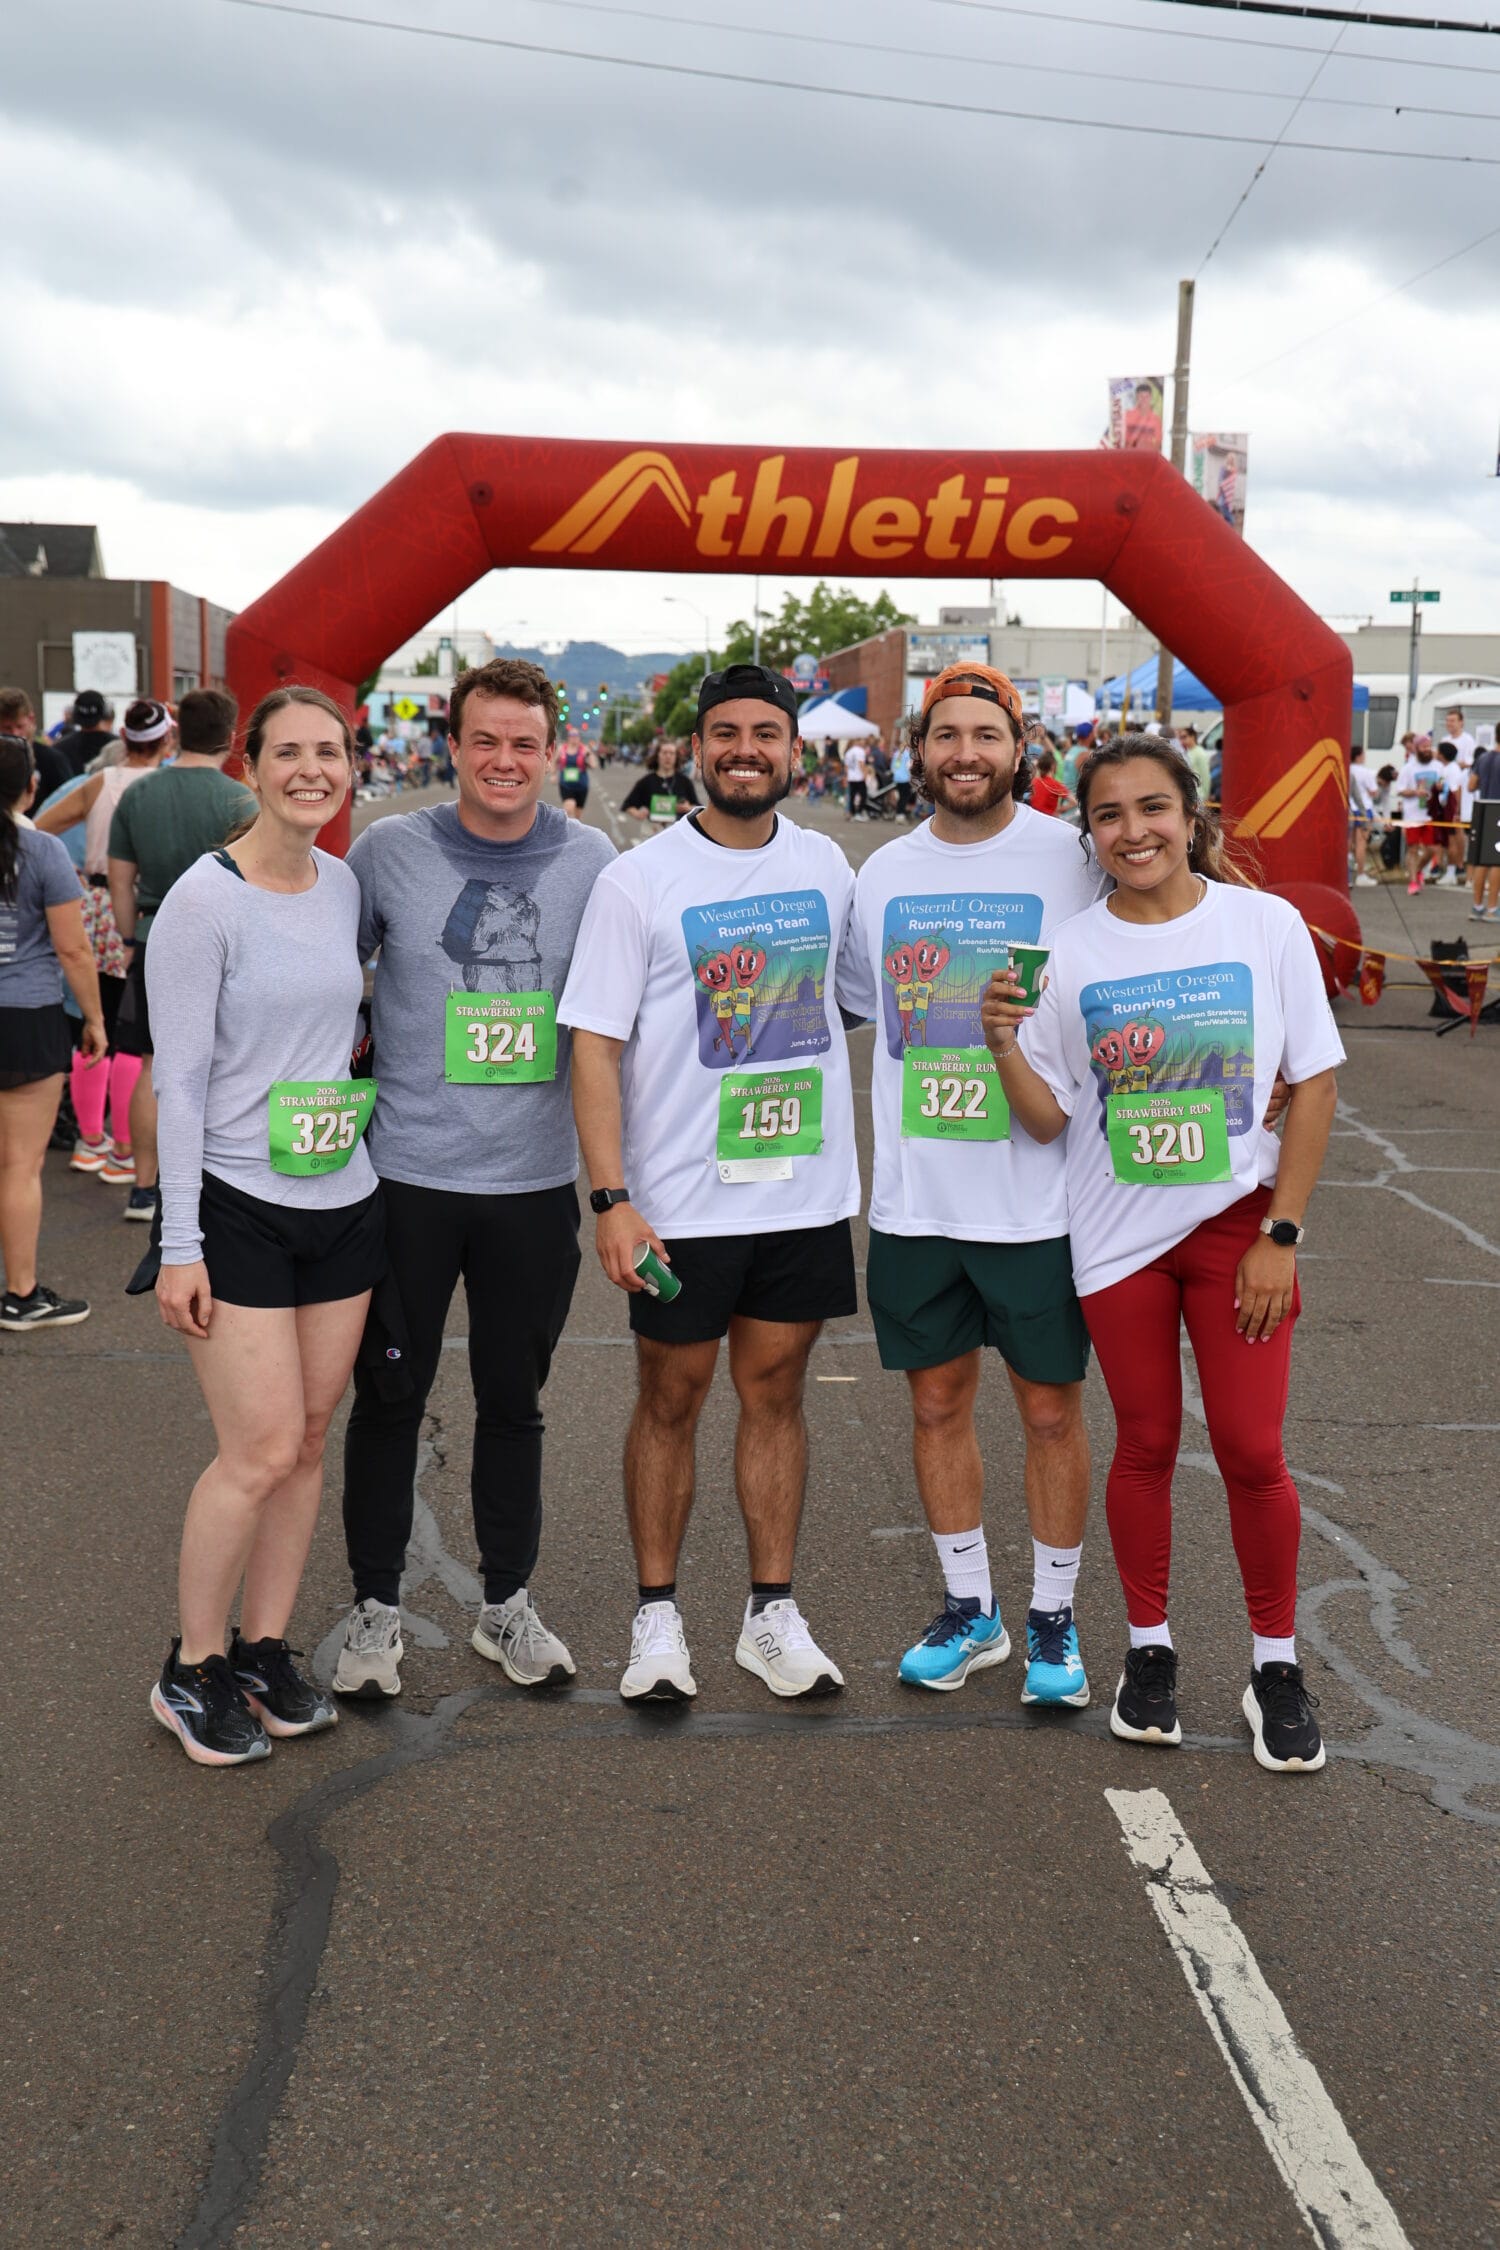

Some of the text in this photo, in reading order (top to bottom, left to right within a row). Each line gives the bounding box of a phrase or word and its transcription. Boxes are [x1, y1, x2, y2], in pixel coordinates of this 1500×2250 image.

[698, 899, 817, 924] WesternU Oregon
[899, 899, 1024, 916] WesternU Oregon
[718, 917, 810, 938] Running Team
[908, 918, 1006, 932] Running Team
[771, 938, 800, 947] Lebanon
[1094, 973, 1236, 1001] WesternU Oregon
[490, 999, 512, 1007] 2026
[1112, 990, 1221, 1016] Running Team
[456, 1006, 545, 1017] STRAWBERRY RUN
[1172, 1009, 1248, 1022] Lebanon Strawberry
[1194, 1018, 1248, 1028] Run/Walk 2026
[466, 1021, 538, 1063] 324
[941, 1053, 961, 1062] 2026
[912, 1061, 998, 1073] STRAWBERRY RUN
[763, 1076, 781, 1085] 2026
[316, 1087, 338, 1096] 2026
[730, 1081, 813, 1097] STRAWBERRY RUN
[279, 1091, 368, 1107] STRAWBERRY RUN
[920, 1077, 988, 1119] 322
[1149, 1098, 1171, 1107] 2026
[738, 1097, 802, 1139] 159
[1116, 1106, 1185, 1119] STRAWBERRY
[1189, 1103, 1212, 1115] RUN
[291, 1109, 359, 1155] 325
[1128, 1120, 1206, 1166] 320
